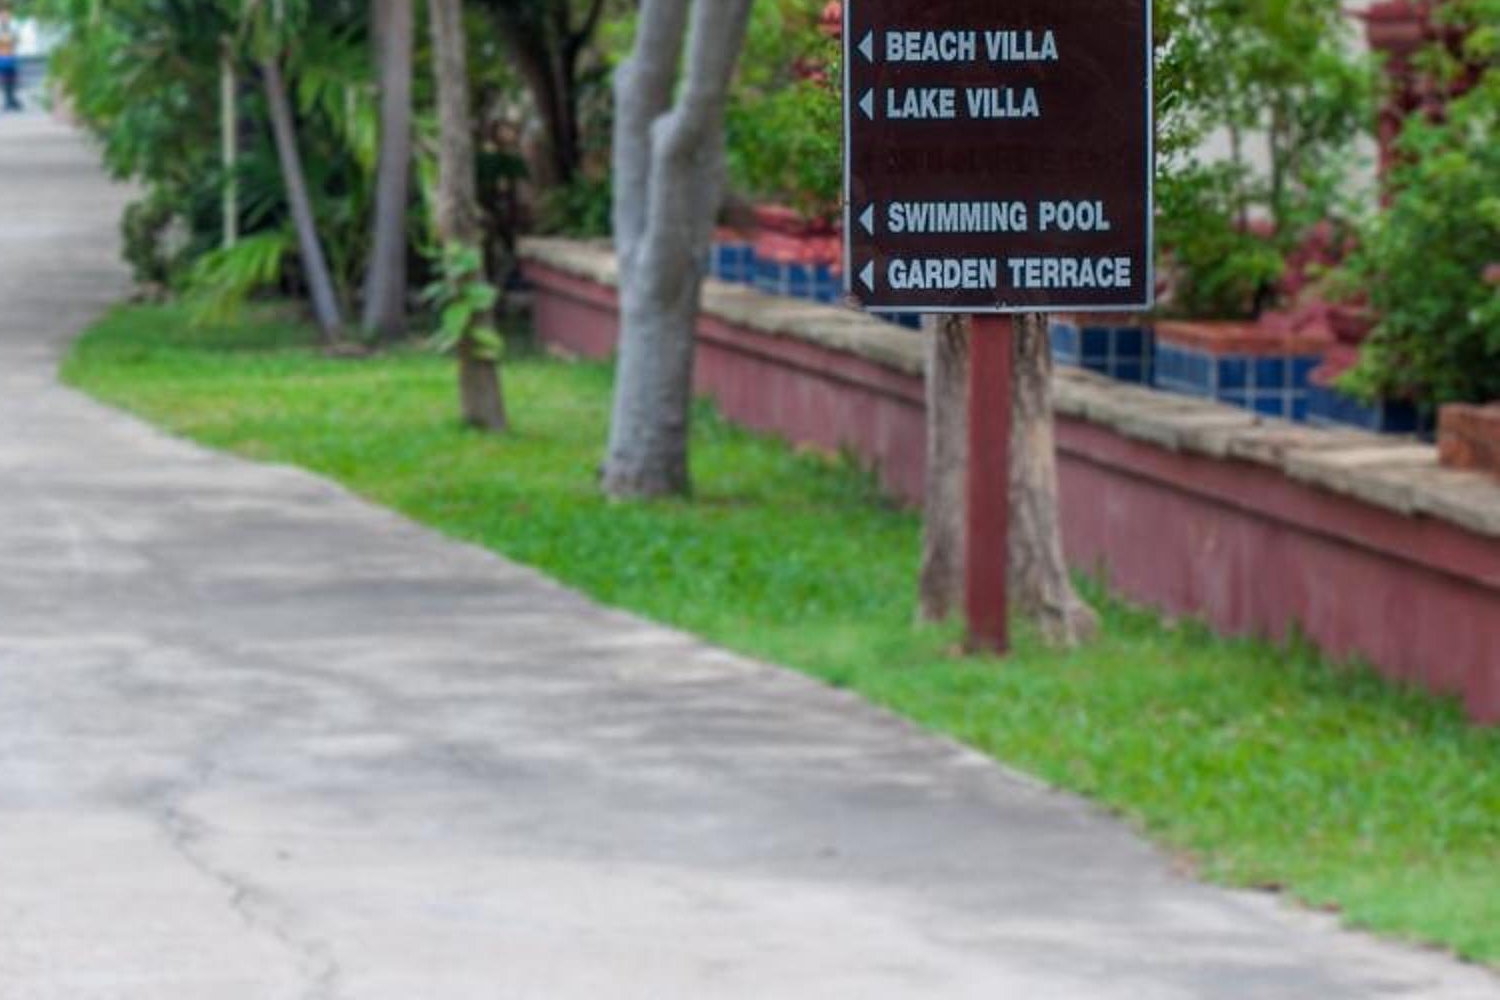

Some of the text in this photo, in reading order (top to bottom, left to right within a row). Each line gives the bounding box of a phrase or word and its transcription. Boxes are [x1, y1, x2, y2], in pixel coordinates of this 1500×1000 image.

[886, 30, 1059, 61] BEACH VILLA
[887, 87, 1041, 118] LAKE VILLA
[887, 200, 1111, 233] SWIMMING POOL
[887, 257, 1131, 289] GARDEN TERRACE
